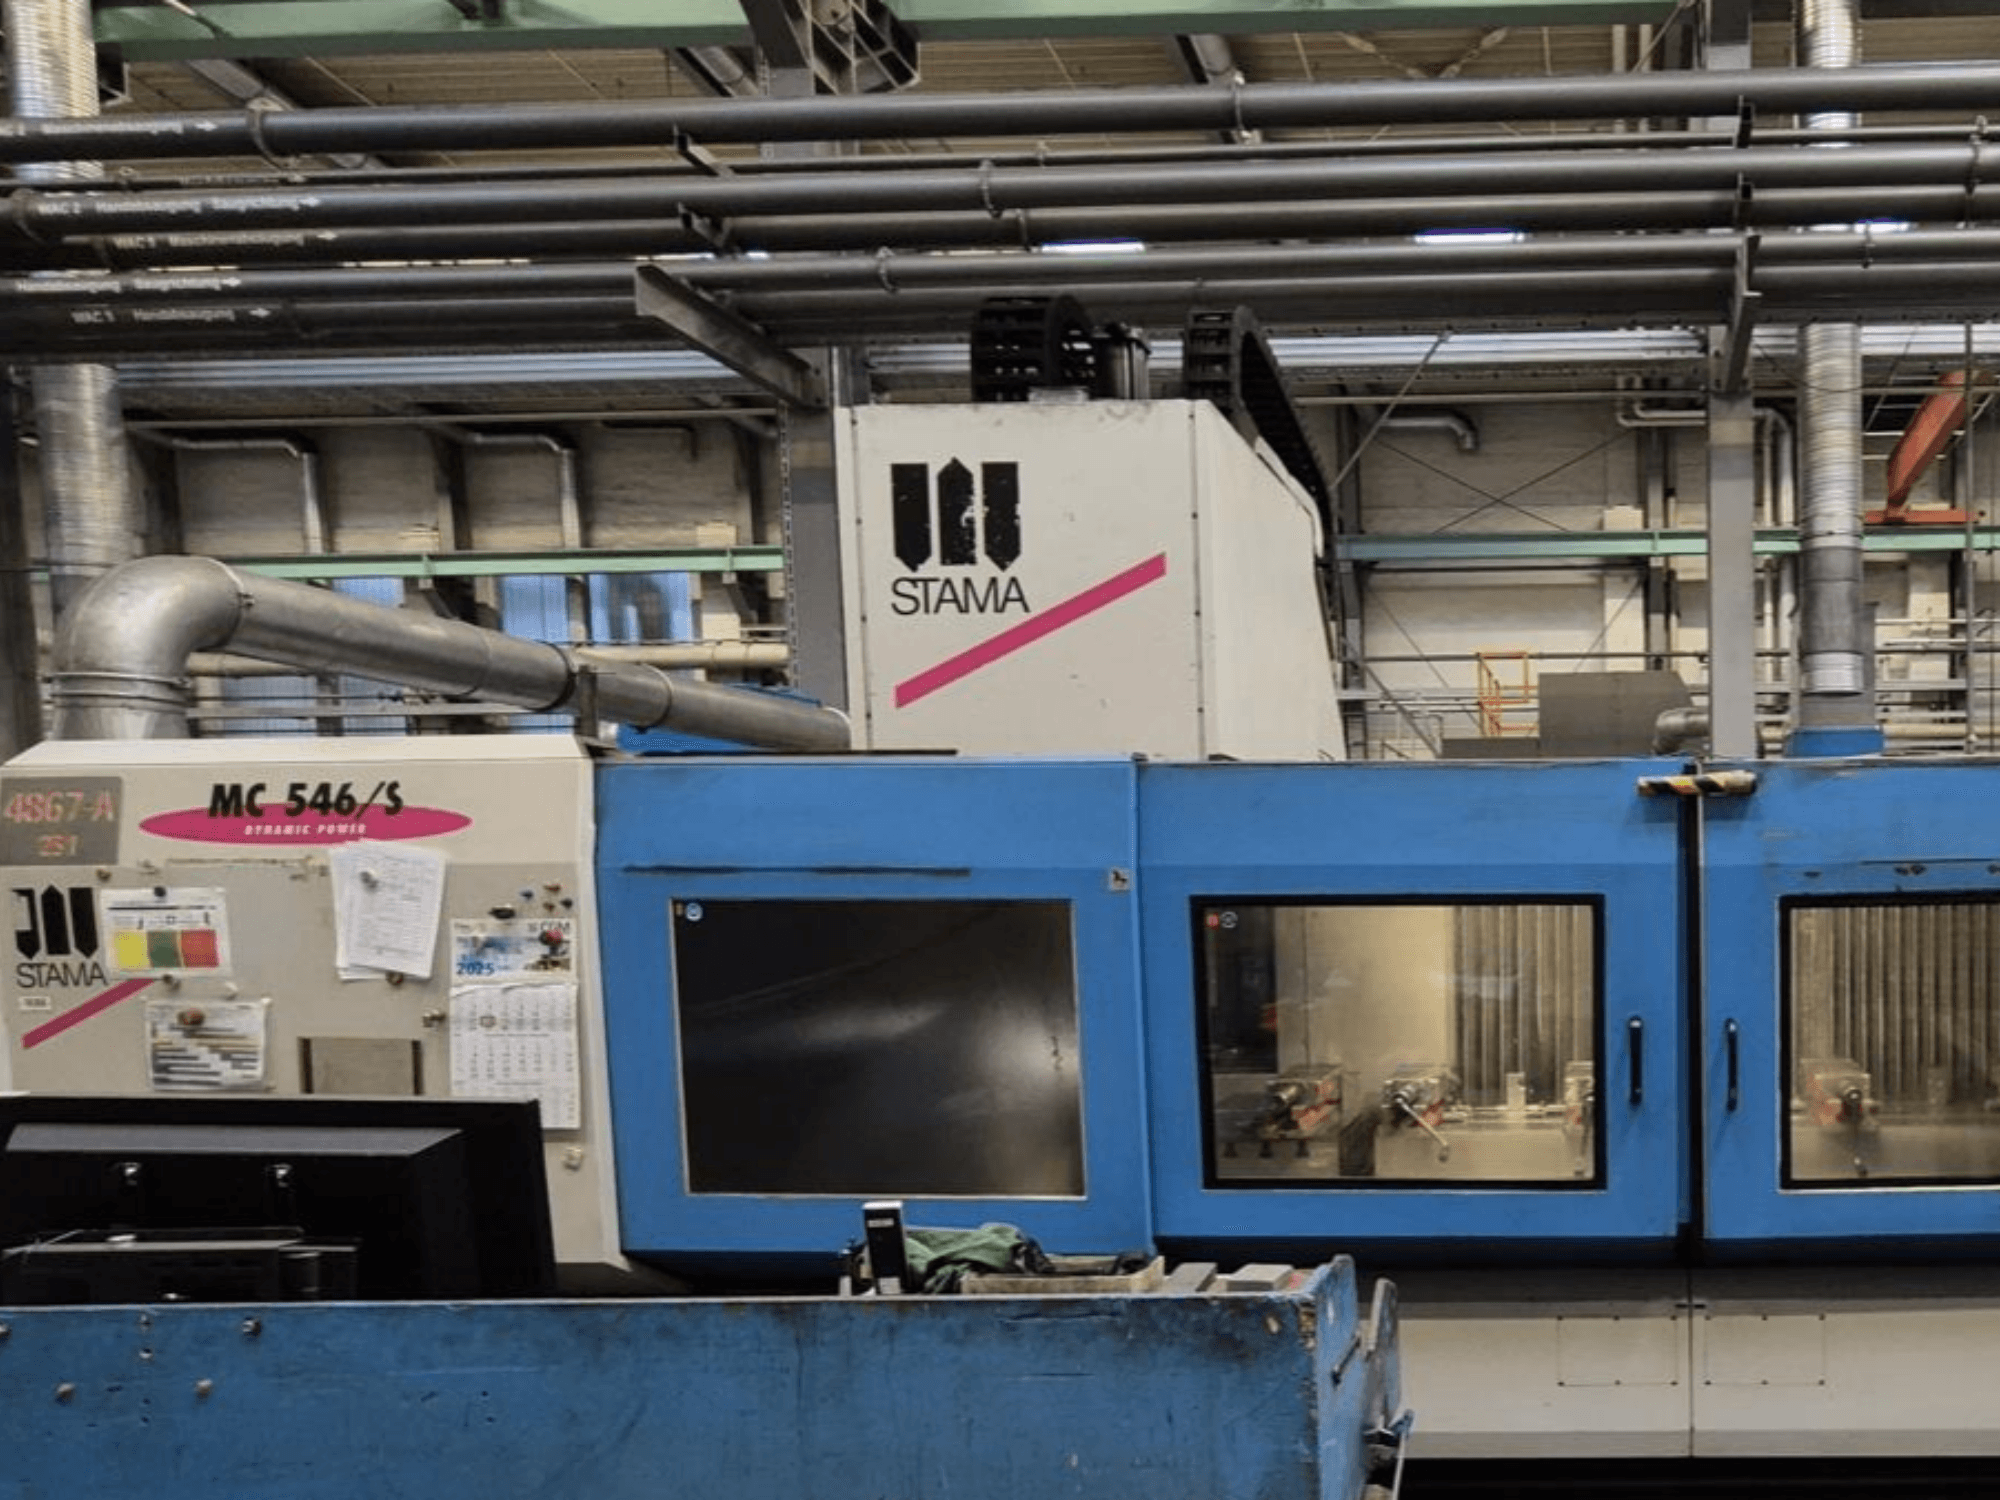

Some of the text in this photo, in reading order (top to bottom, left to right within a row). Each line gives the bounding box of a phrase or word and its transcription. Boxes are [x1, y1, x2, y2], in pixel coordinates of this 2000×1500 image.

[890, 576, 1030, 615] STAMA
[208, 781, 403, 821] MC 546/S
[17, 962, 110, 988] STAMA
